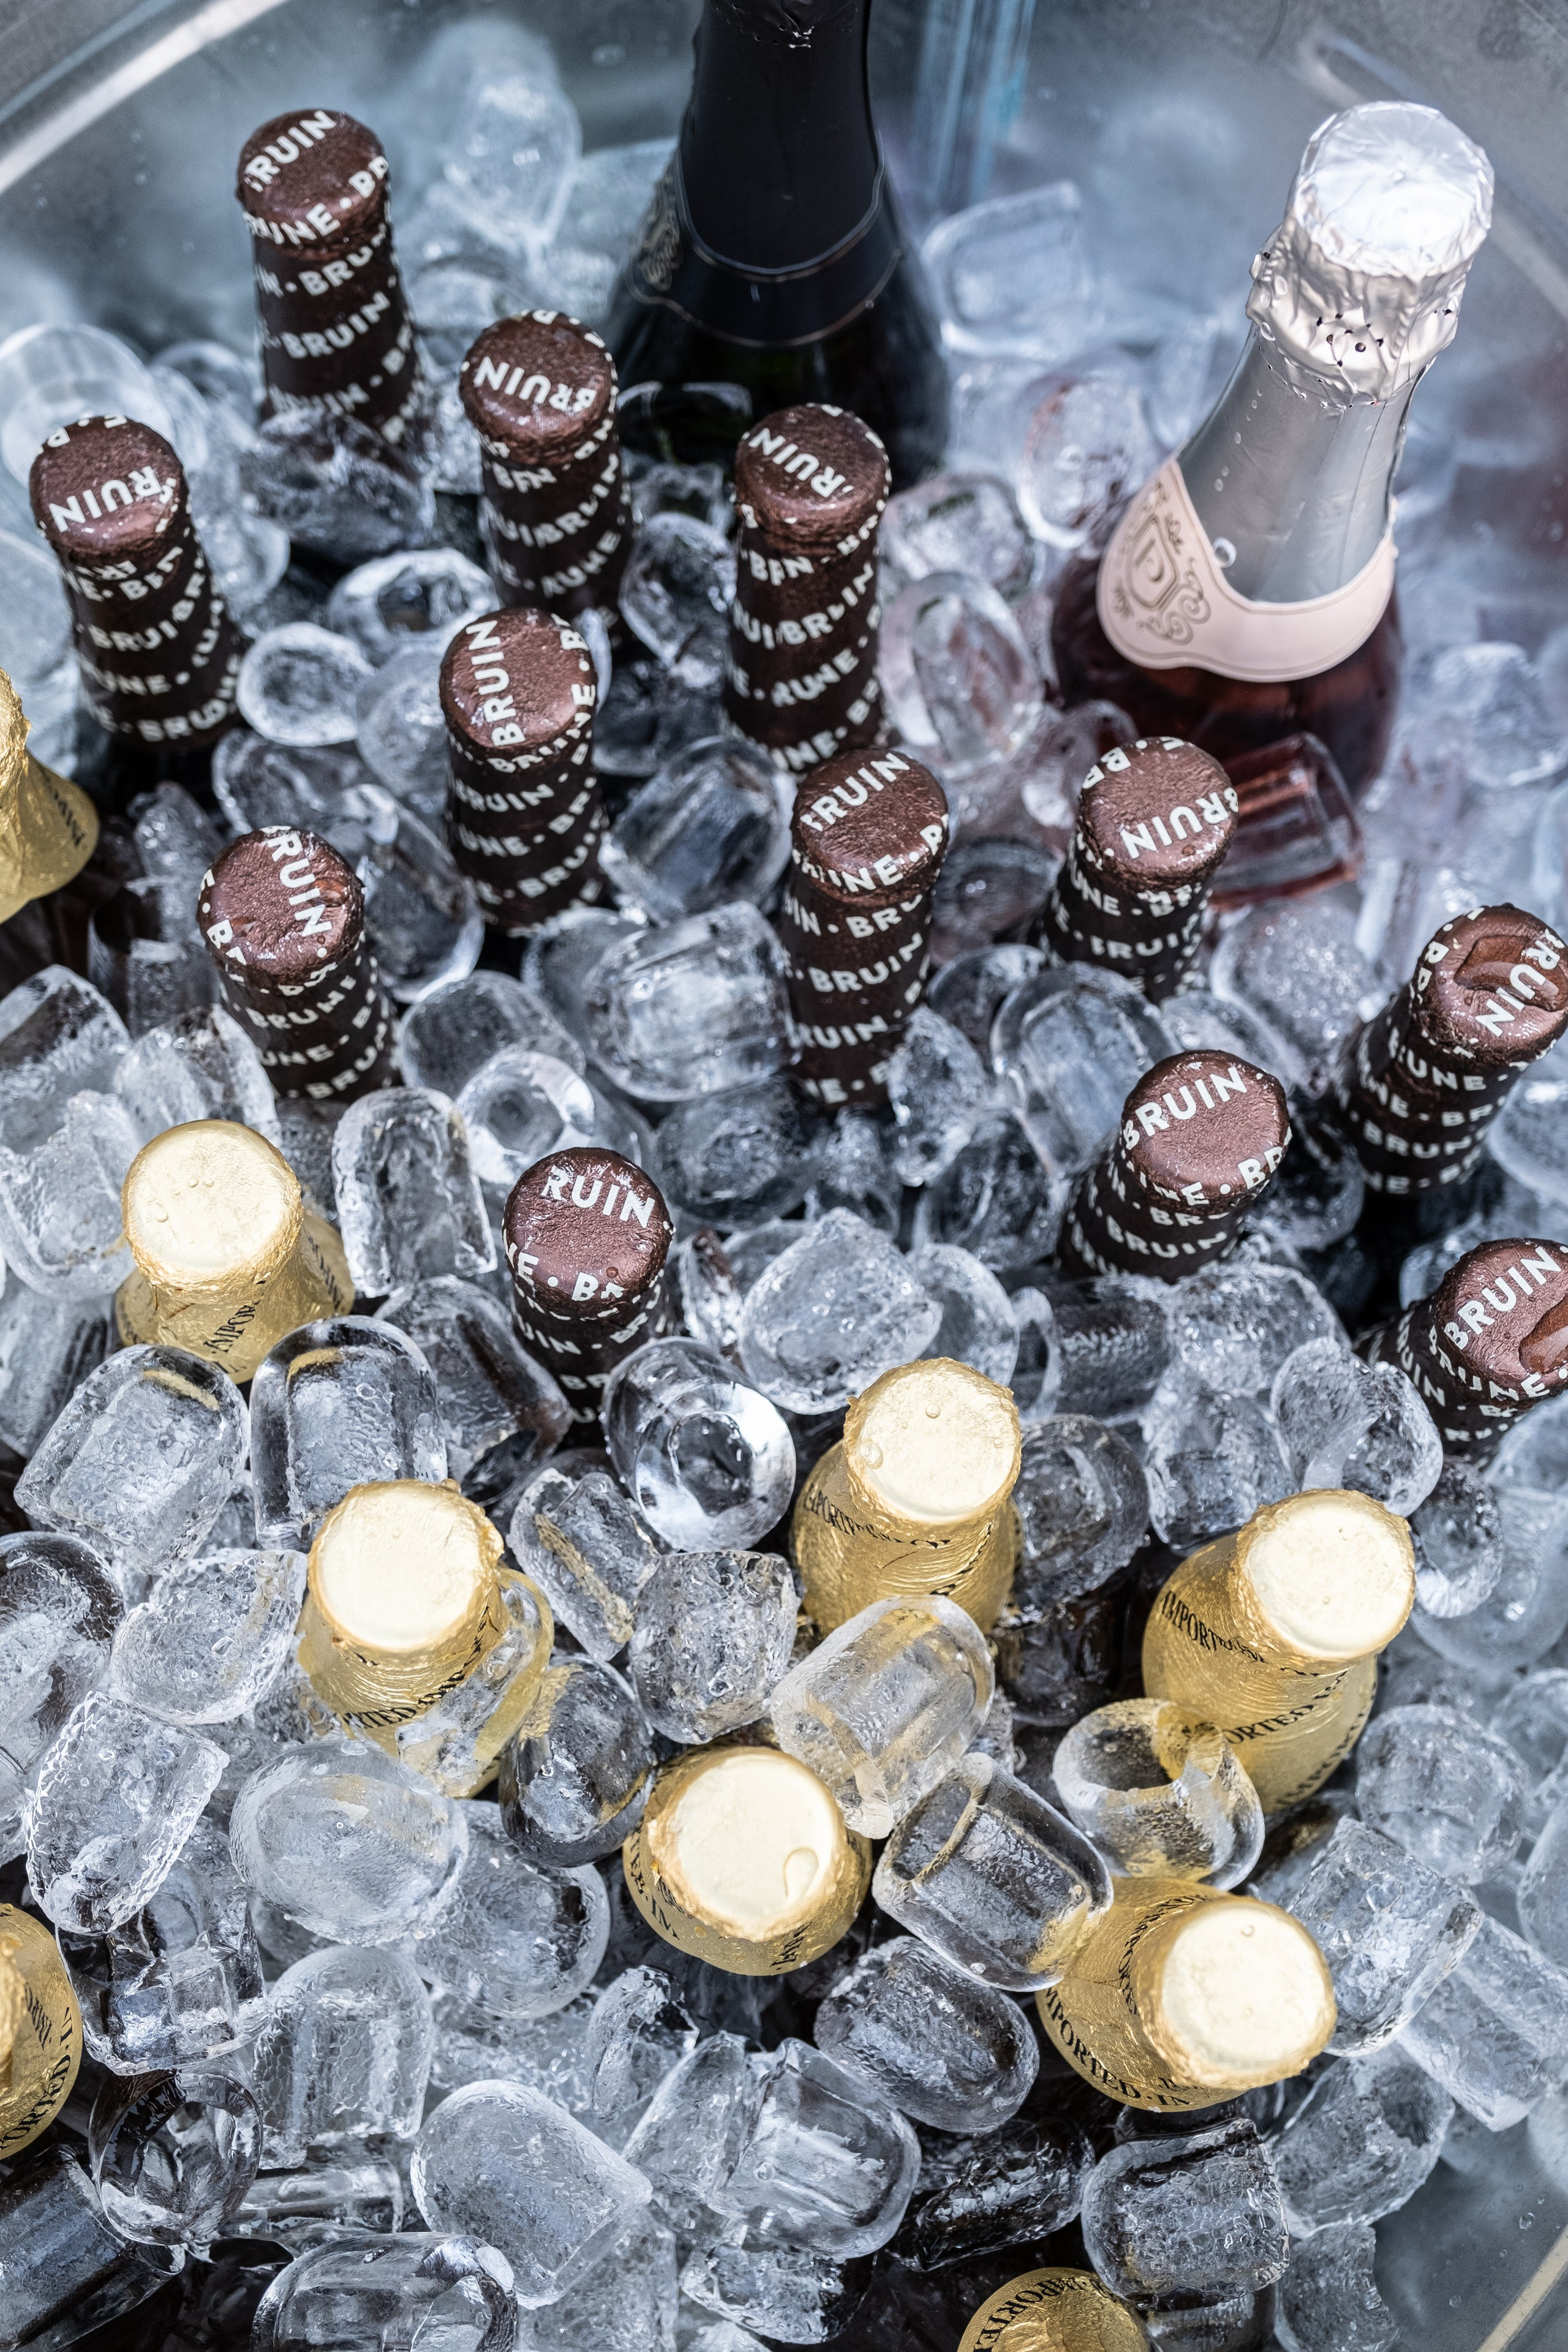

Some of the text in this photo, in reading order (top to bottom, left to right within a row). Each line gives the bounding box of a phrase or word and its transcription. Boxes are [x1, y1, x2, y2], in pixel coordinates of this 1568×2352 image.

[279, 290, 391, 360] BRUIN
[473, 356, 597, 414] BRUIN
[748, 428, 854, 498] RUIN
[466, 620, 526, 747] BRUIN
[807, 932, 923, 993] BRUIN
[1123, 1066, 1248, 1151] BRUIN
[1106, 1214, 1227, 1259] BRUIN
[1443, 1246, 1562, 1351] BRUIN
[1045, 1988, 1142, 2100] MPORTED
